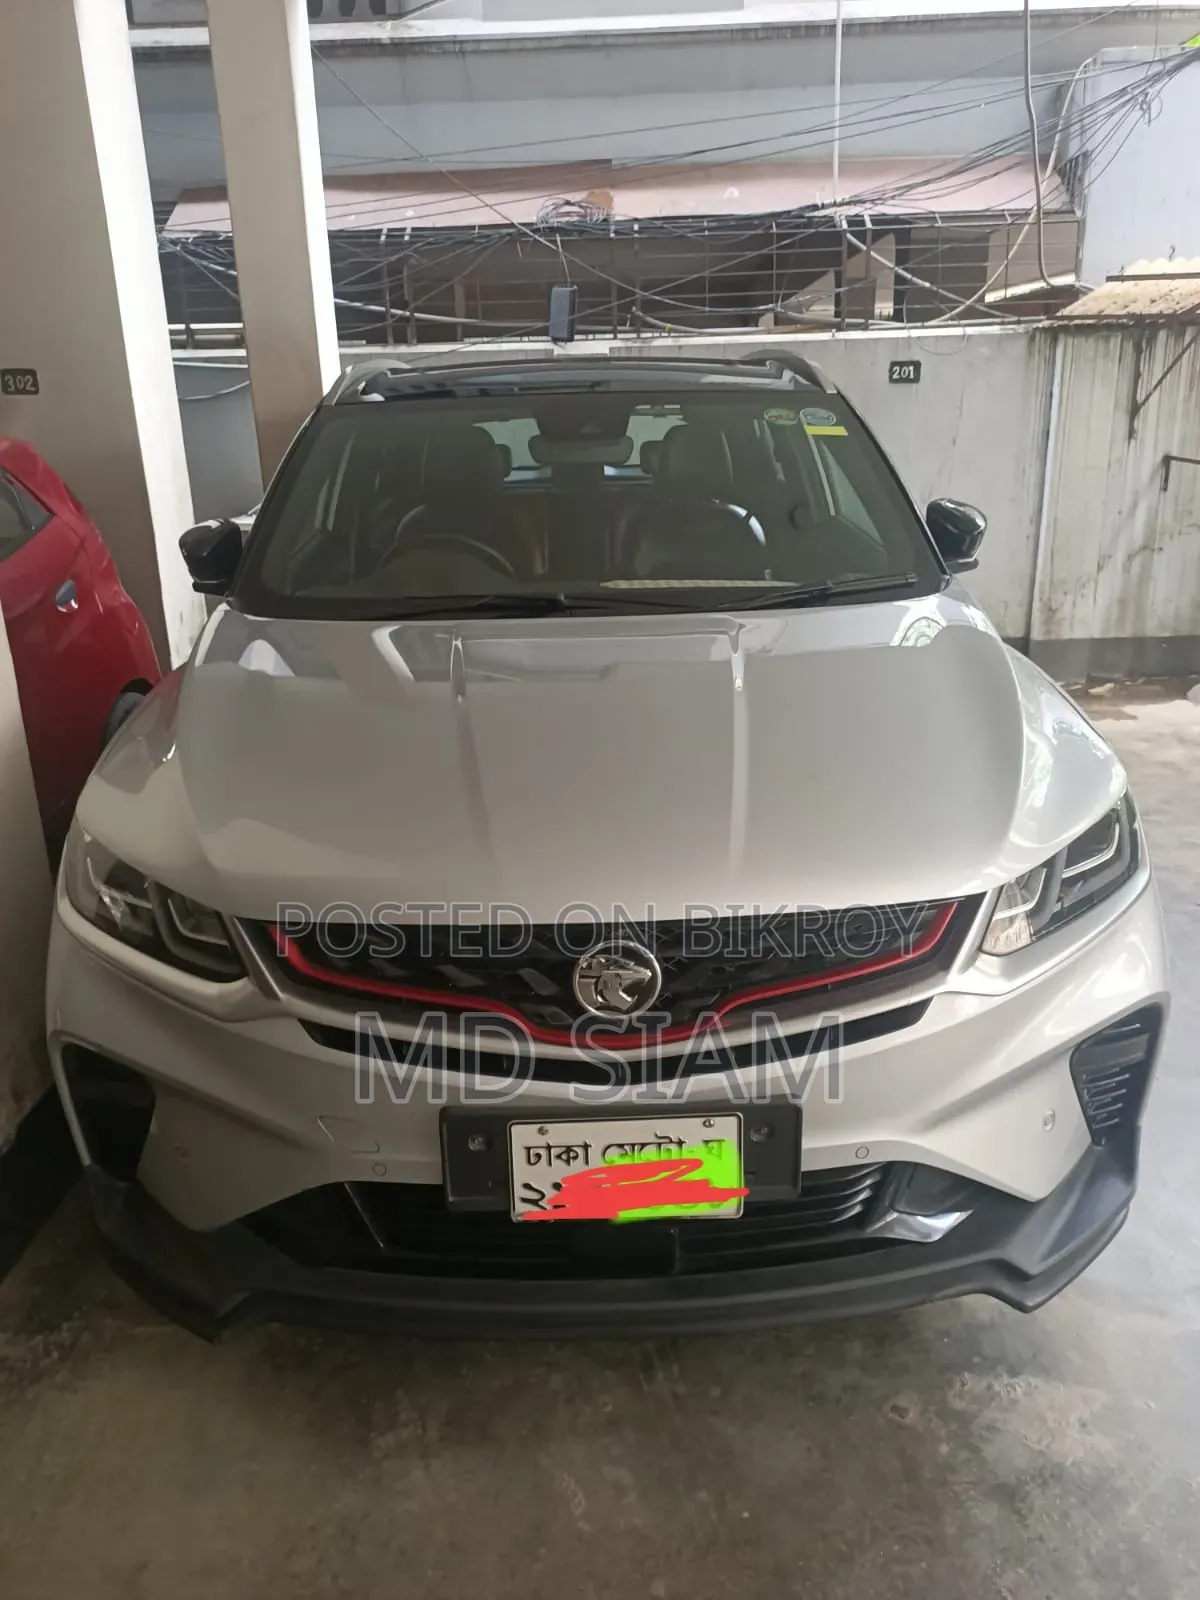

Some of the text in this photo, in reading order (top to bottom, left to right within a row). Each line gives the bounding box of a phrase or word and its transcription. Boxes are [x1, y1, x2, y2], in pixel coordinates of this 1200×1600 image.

[892, 365, 914, 379] 201
[4, 374, 36, 391] 302
[522, 1141, 592, 1167] ঢাকা
